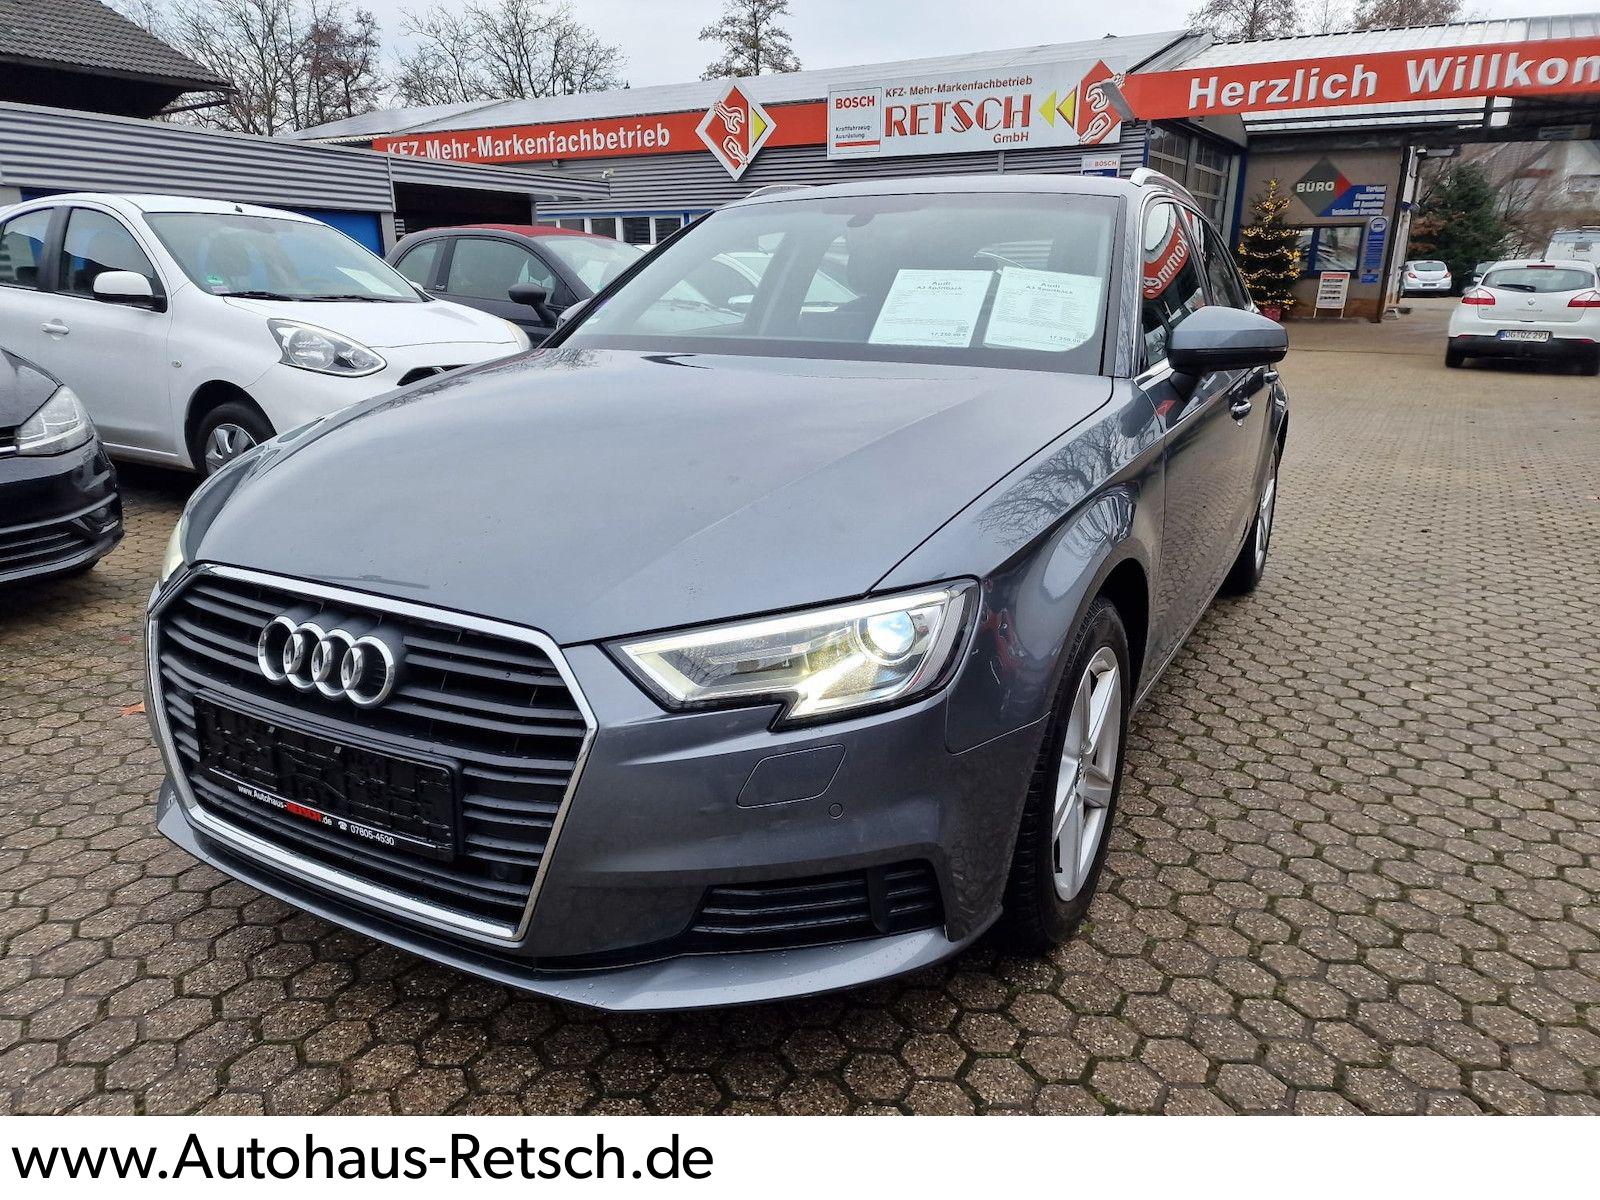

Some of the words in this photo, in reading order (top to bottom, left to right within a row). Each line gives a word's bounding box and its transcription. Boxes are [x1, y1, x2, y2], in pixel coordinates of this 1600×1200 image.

[885, 87, 907, 98] KFZ-
[909, 75, 1033, 97] Mehr-Markenfachbetrieb
[1188, 64, 1379, 111] Herzlich
[835, 95, 875, 110] BOSCH
[884, 93, 1033, 138] RETSCH
[993, 131, 1029, 145] GmbH
[1296, 180, 1335, 193] BÜRO
[350, 825, 395, 846] 07805-4530
